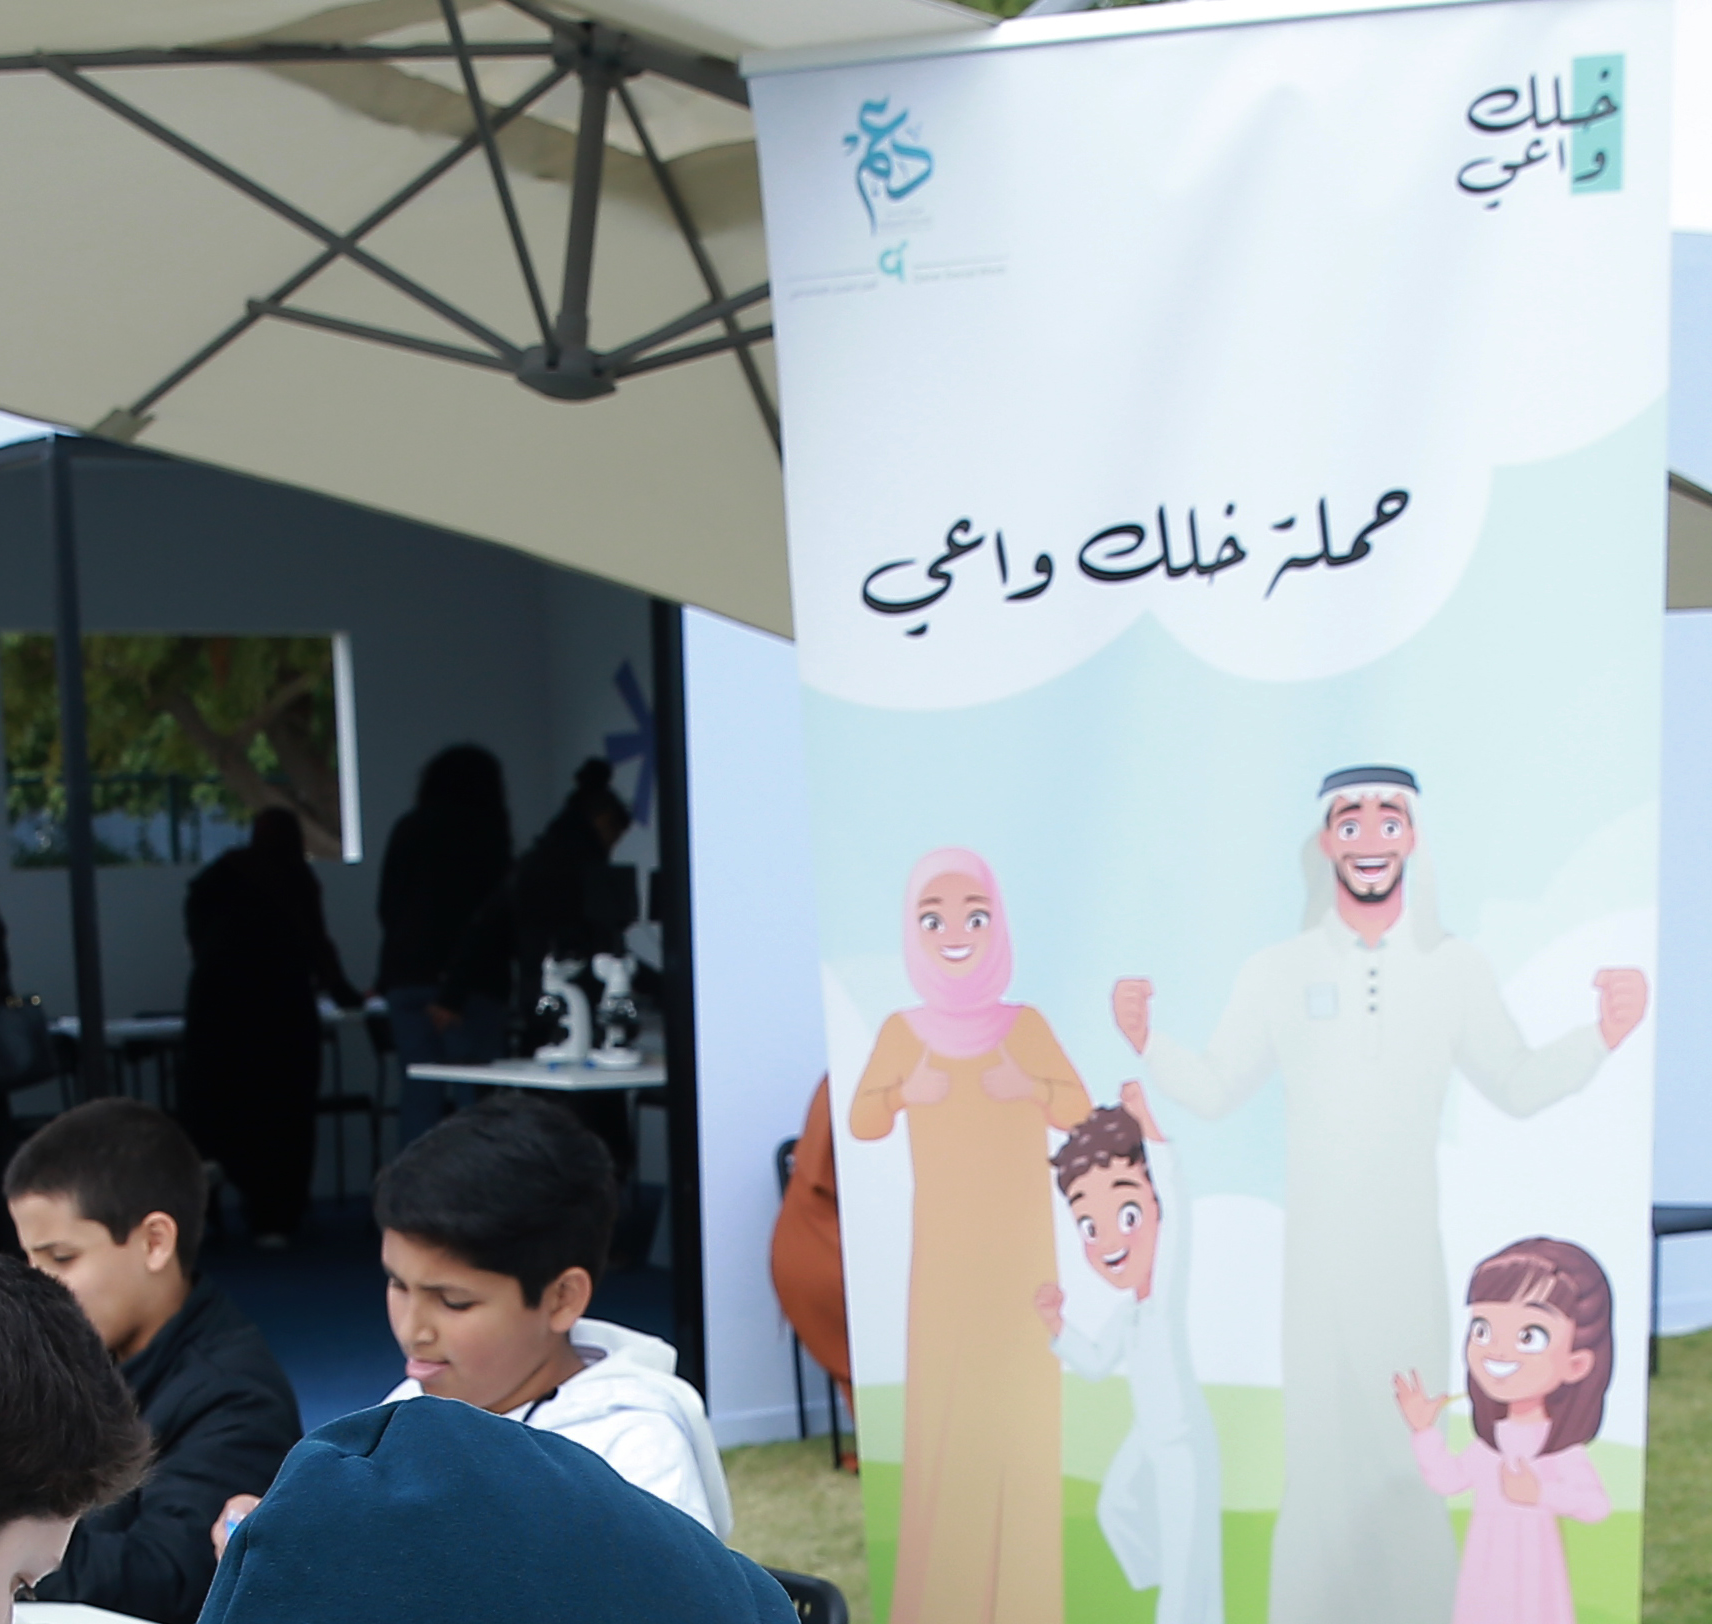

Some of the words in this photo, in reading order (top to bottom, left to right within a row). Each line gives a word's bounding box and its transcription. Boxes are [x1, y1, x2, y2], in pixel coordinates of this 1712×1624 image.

[862, 518, 1055, 637] واعي
[1077, 502, 1248, 587] خلك
[1262, 488, 1411, 602] حملة
